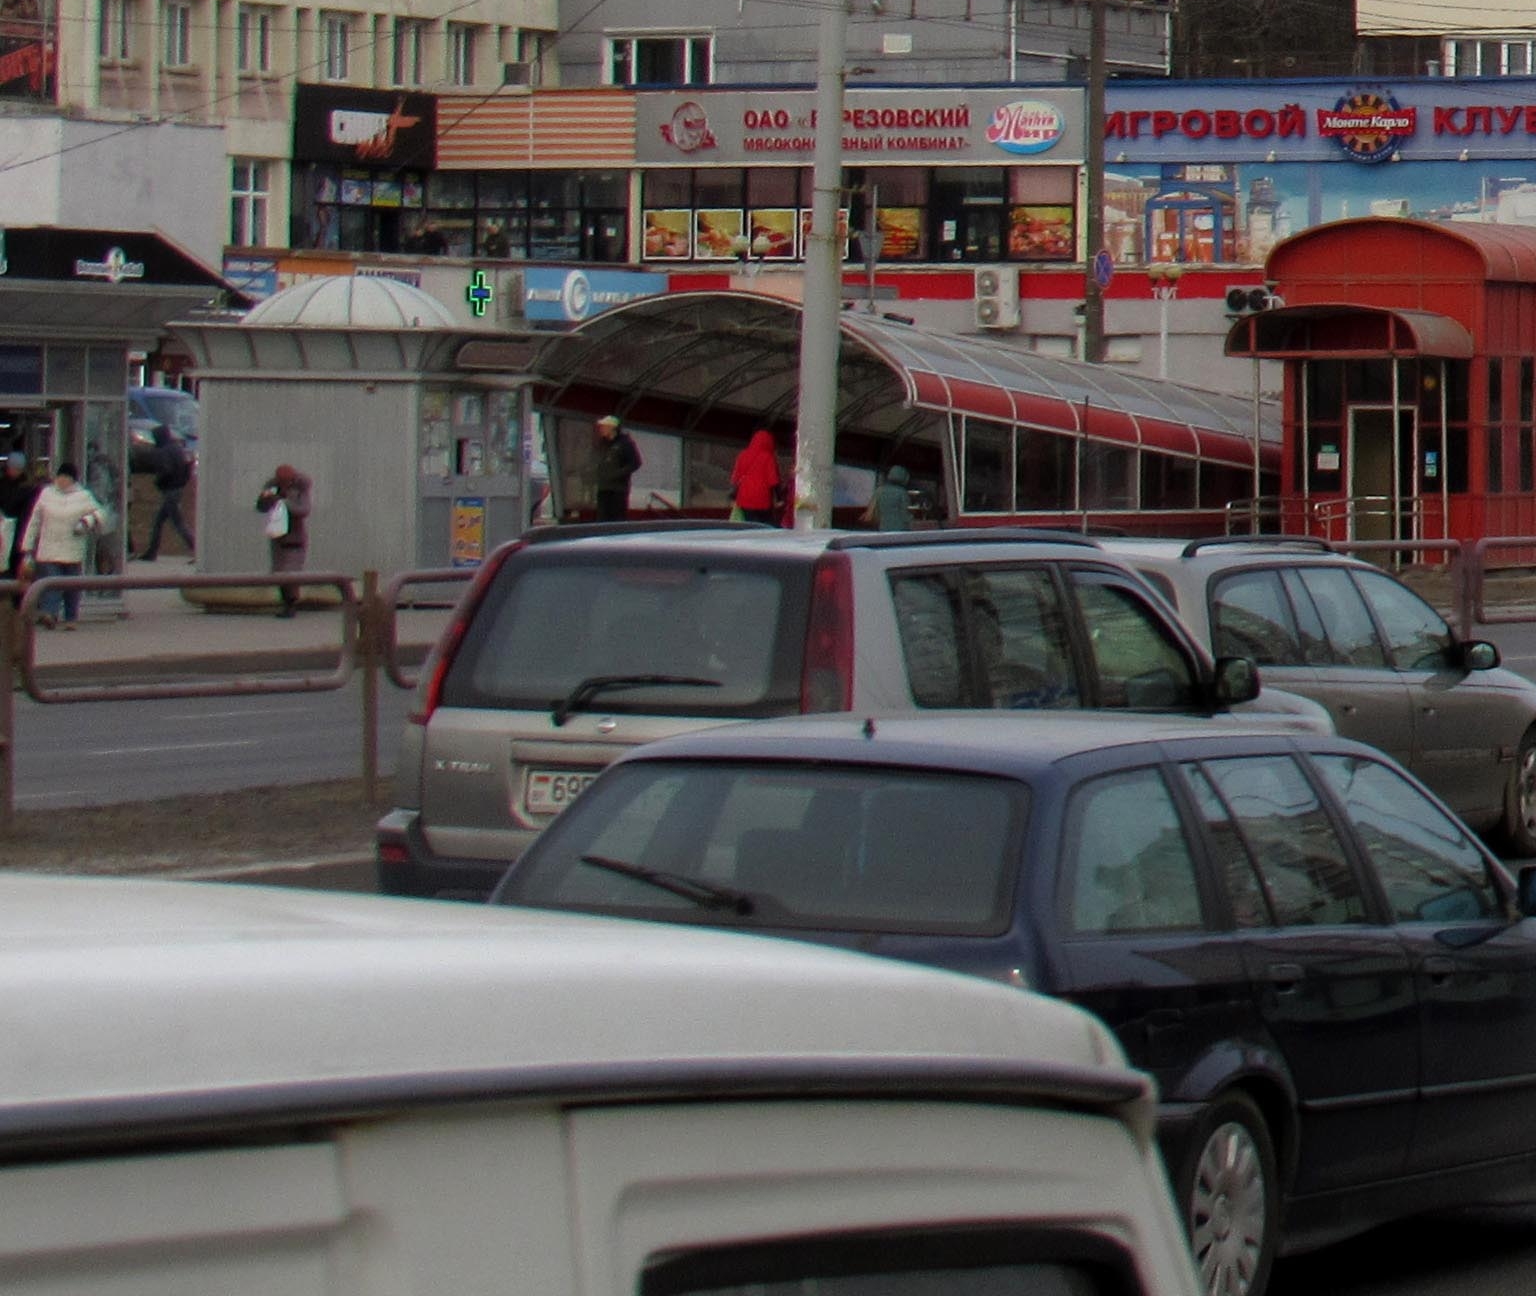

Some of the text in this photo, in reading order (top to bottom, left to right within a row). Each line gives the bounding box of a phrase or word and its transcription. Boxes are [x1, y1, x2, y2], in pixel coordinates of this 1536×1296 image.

[743, 109, 790, 129] ОАО
[1103, 103, 1307, 139] ИГРОВОЙ
[1323, 115, 1409, 131] Монте Карло
